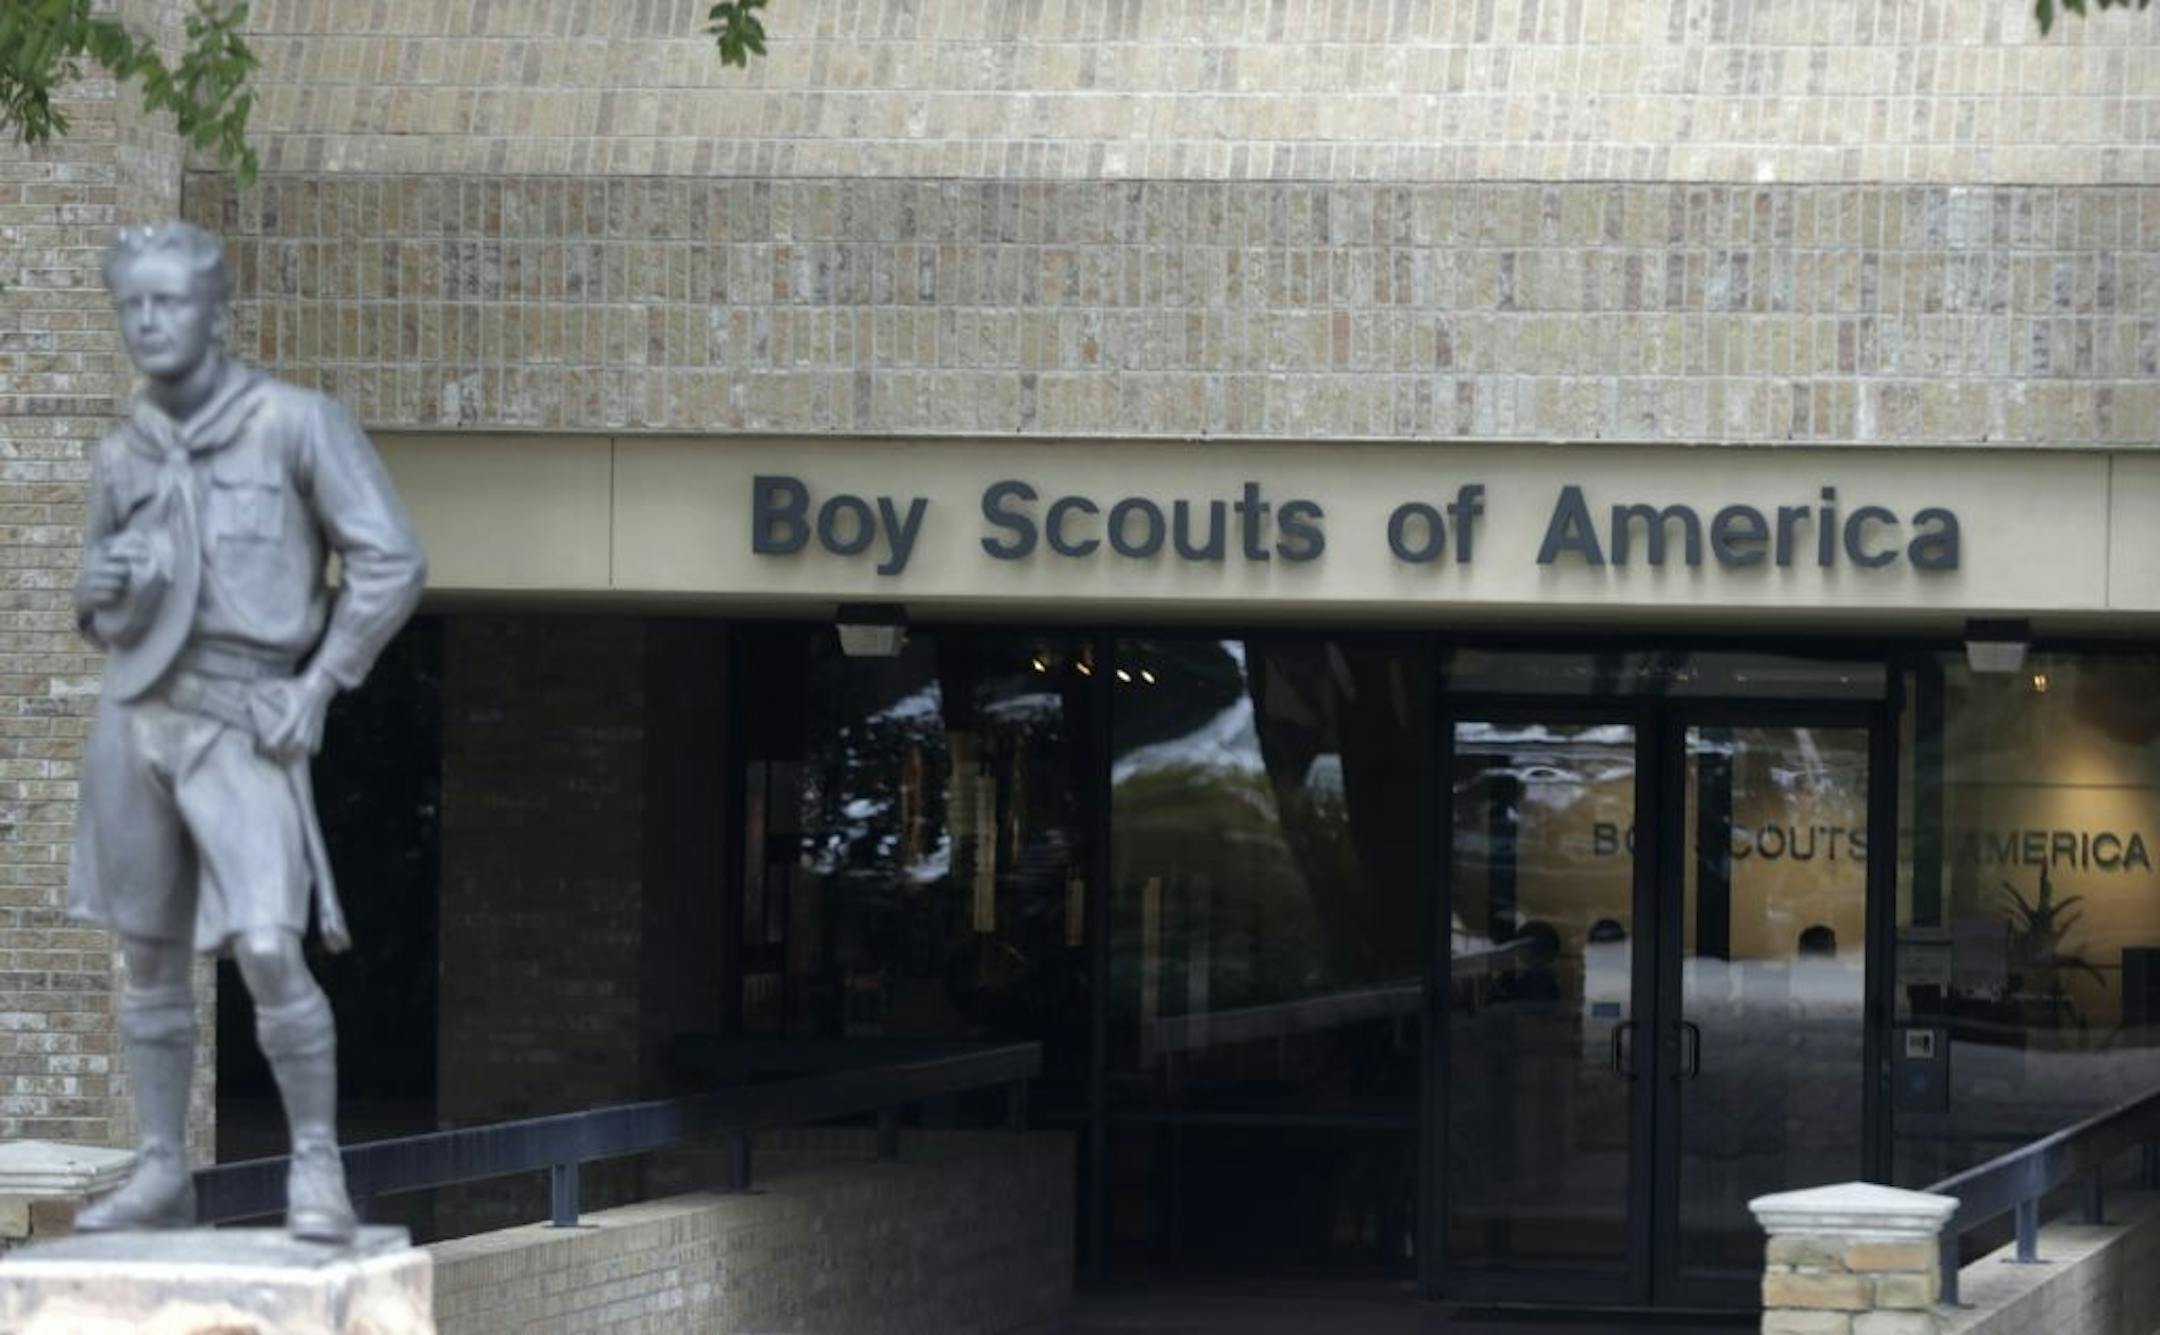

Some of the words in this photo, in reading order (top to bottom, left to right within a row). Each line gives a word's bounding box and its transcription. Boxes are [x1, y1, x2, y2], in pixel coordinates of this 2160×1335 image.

[752, 475, 928, 575] Boy
[981, 480, 1326, 561] Scouts
[1387, 484, 1485, 564] of
[1536, 485, 1960, 570] America
[1695, 823, 1867, 861] COUTS
[1954, 829, 2150, 870] AMERICA
